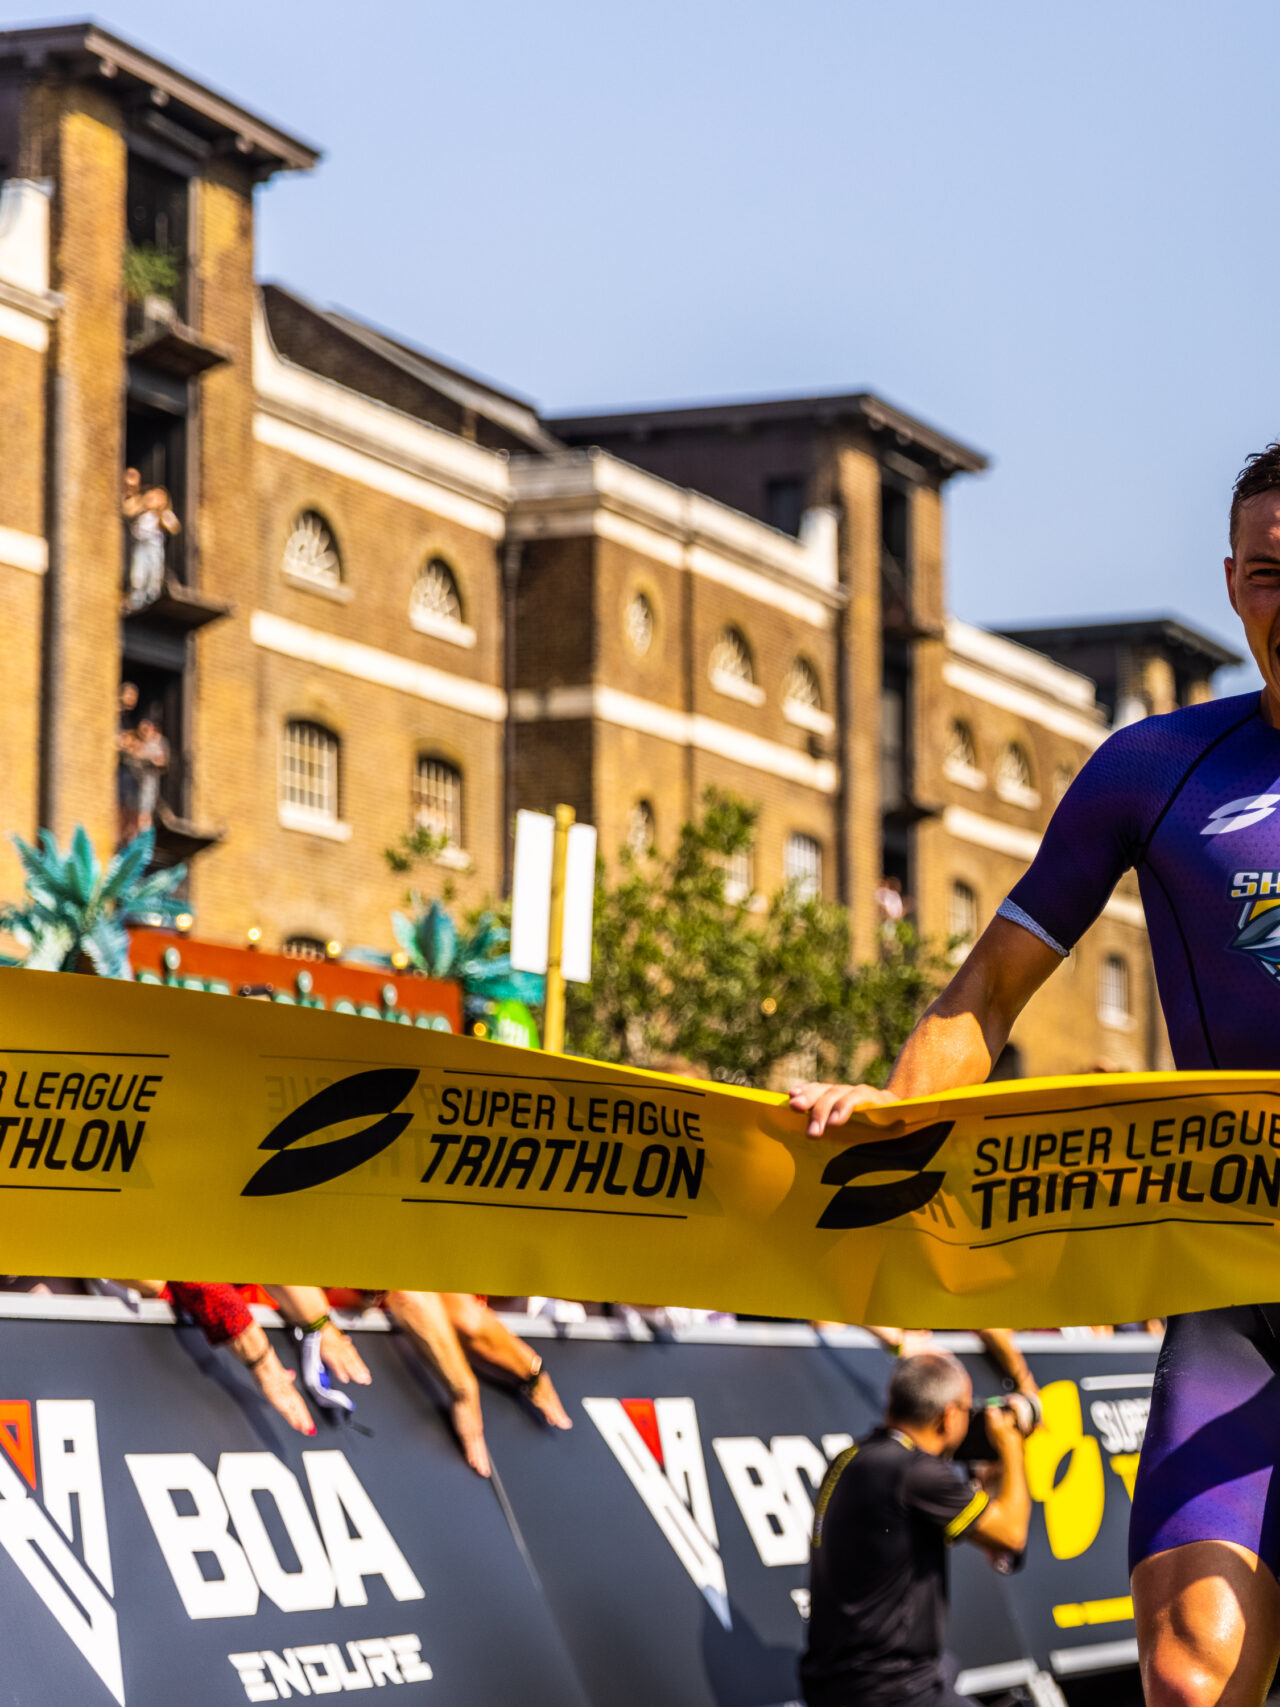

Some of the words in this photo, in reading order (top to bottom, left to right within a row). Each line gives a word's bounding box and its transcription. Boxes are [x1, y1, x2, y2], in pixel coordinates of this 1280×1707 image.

[14, 1071, 163, 1113] LEAGUE
[437, 1087, 556, 1131] SUPER
[566, 1095, 705, 1143] LEAGUE
[420, 1133, 706, 1200] TRIATHLON
[973, 1126, 1113, 1177] SUPER
[124, 1450, 425, 1620] BOA
[228, 1634, 433, 1703] ENDURE
